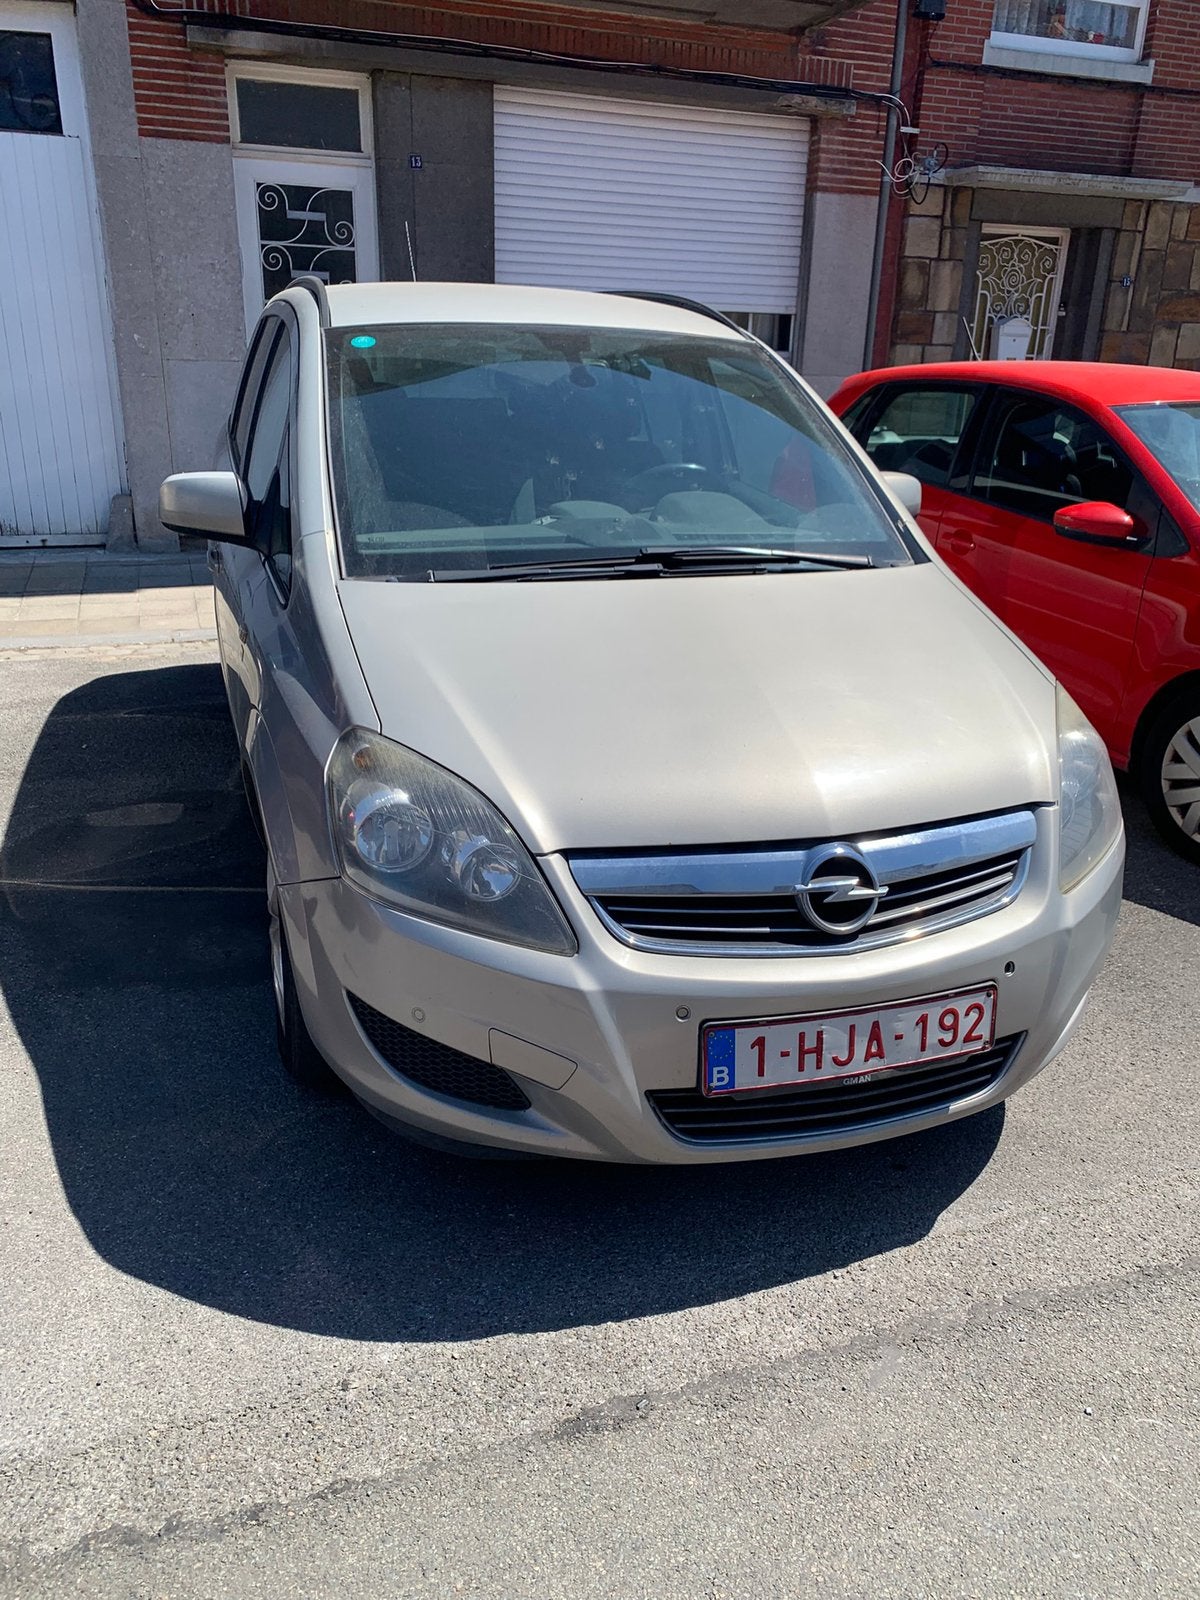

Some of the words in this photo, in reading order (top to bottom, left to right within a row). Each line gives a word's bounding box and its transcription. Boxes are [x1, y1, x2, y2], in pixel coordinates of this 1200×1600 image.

[411, 156, 421, 167] 13
[1123, 277, 1131, 287] 15
[750, 1002, 985, 1077] 1-HJA-192
[712, 1066, 730, 1086] B
